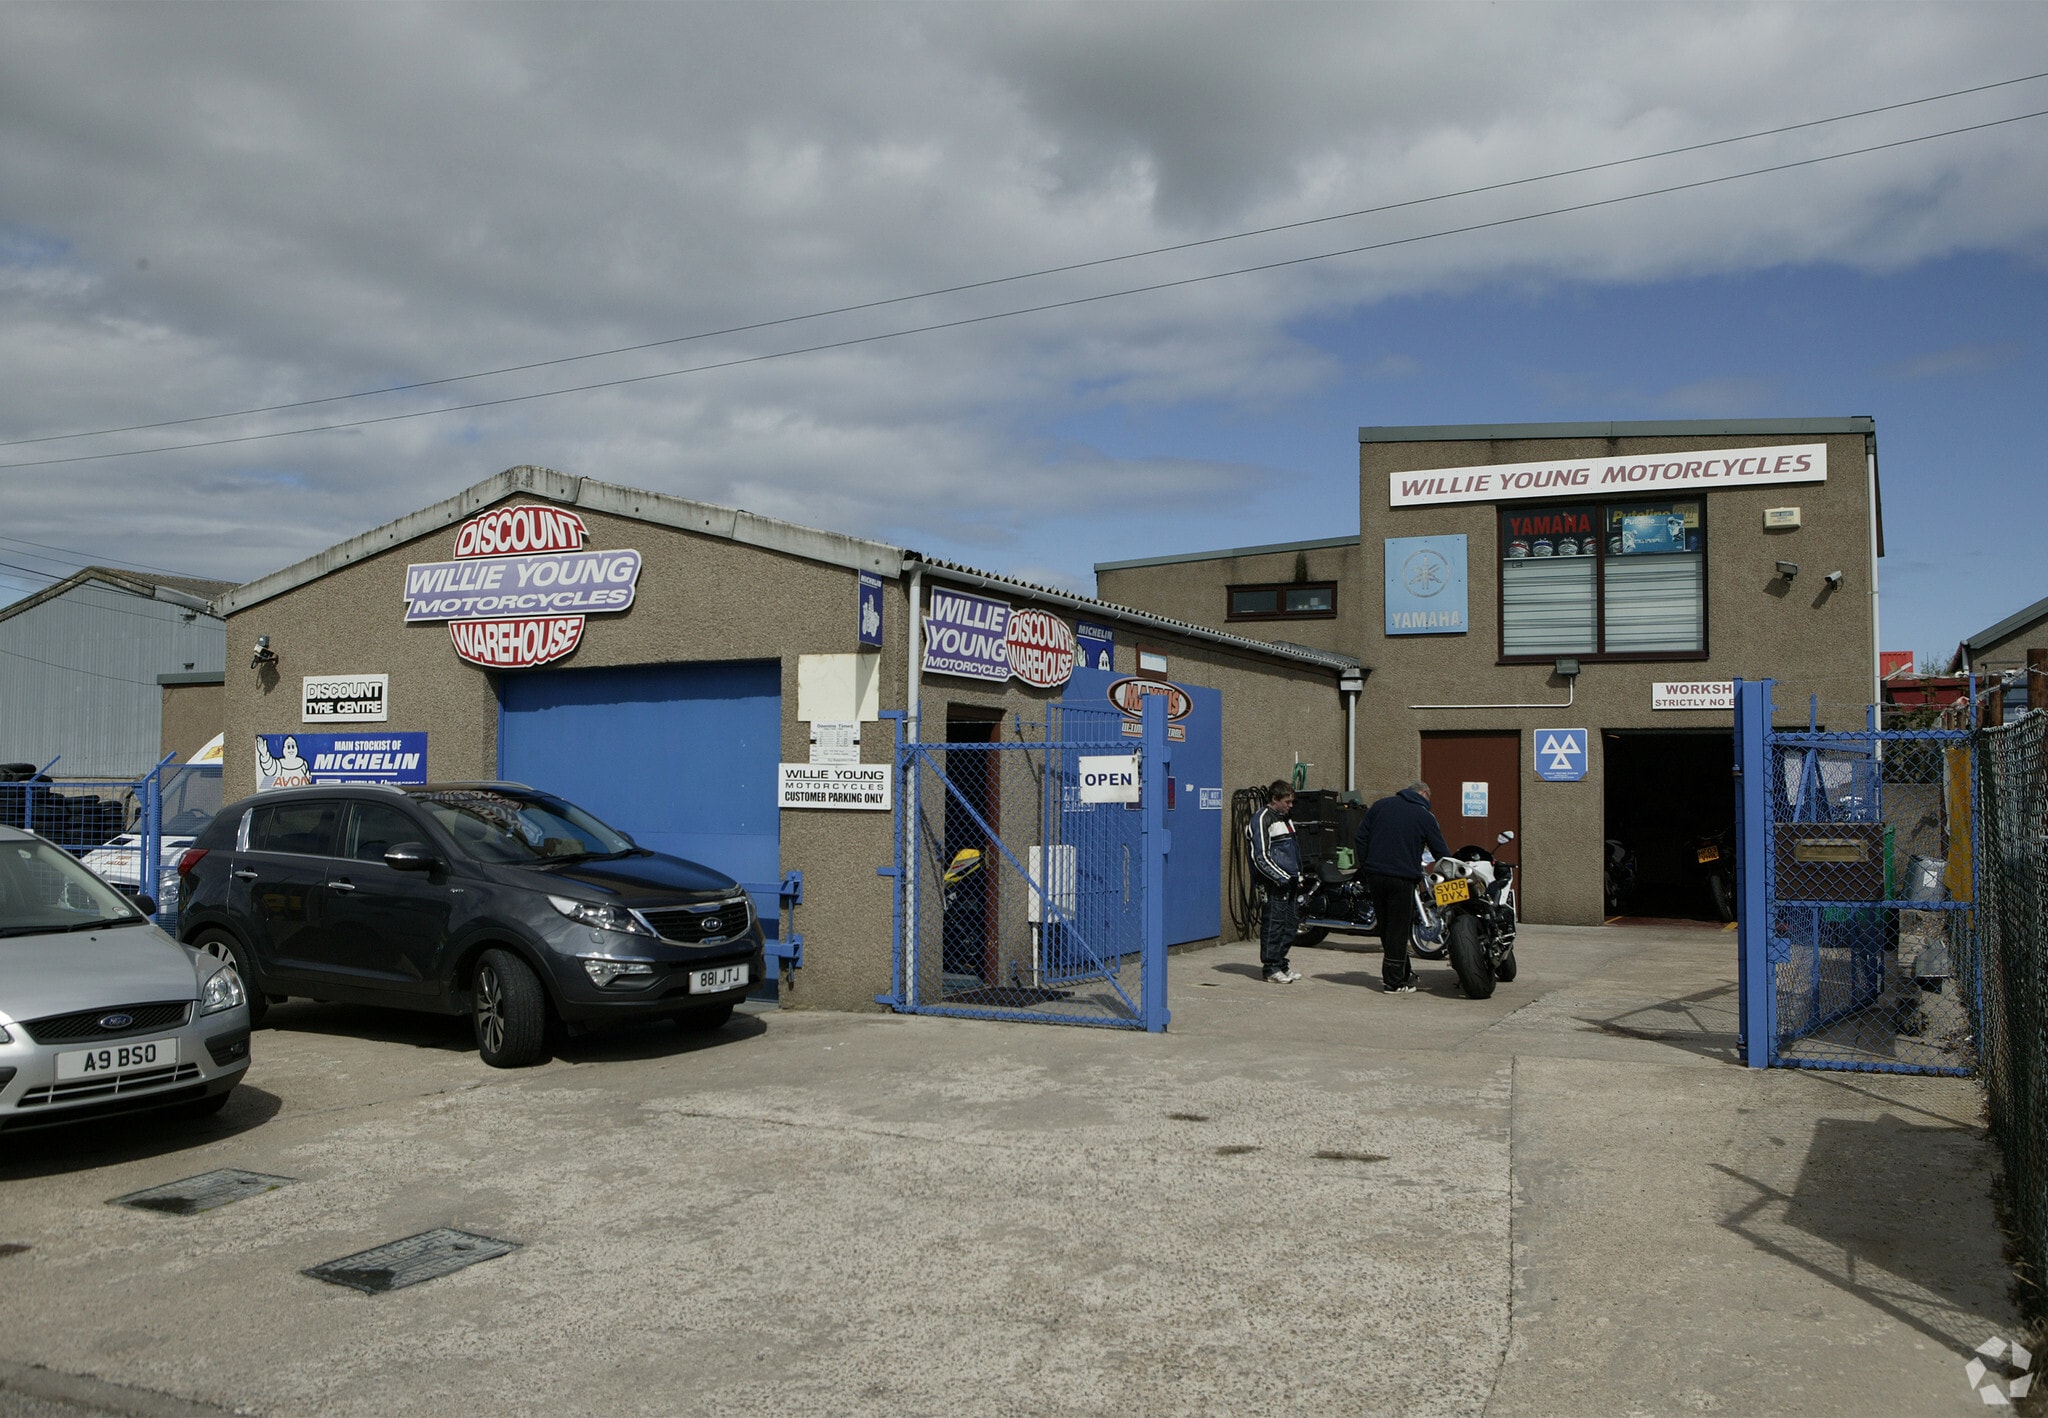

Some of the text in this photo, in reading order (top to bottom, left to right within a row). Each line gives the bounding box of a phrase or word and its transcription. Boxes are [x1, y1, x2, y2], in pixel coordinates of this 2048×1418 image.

[1401, 453, 1813, 497] WILLIE YOUNG MOTORCYCLES
[457, 509, 579, 555] DISCOUNT
[1510, 513, 1591, 536] YAMAHA
[409, 557, 634, 594] WILLIE YOUNG
[860, 574, 882, 588] MICHELIN
[412, 589, 628, 614] MOTORCYCLES
[934, 595, 1006, 632] WILLIE
[1392, 610, 1461, 628] YAMAHA
[1007, 610, 1075, 649] DISCOUNT
[1080, 625, 1113, 640] MICHELIN
[452, 619, 580, 663] WAREHOUSE
[929, 625, 1007, 662] YOUNG
[926, 655, 1009, 678] MOTORCYCLES
[1006, 644, 1073, 684] WAREHOUSE
[306, 682, 383, 699] DISCOUNT
[1665, 684, 1732, 694] WORKSH
[307, 700, 382, 714] TYRE CENTRE
[1655, 698, 1706, 707] STRICTLY
[334, 740, 402, 752] MAIN STOCKIST OF
[313, 753, 420, 770] MICHELIN
[273, 776, 310, 787] AVON
[785, 770, 884, 780] WILLIE YOUNG
[1084, 773, 1133, 787] OPEN
[785, 782, 884, 790] MOTORCYCLES
[784, 791, 884, 804] CUSTOMER PARKING ONLY
[1435, 880, 1466, 895] SV08
[1441, 890, 1464, 903] DVX
[720, 967, 740, 984] JTJ
[84, 1050, 111, 1072] A9
